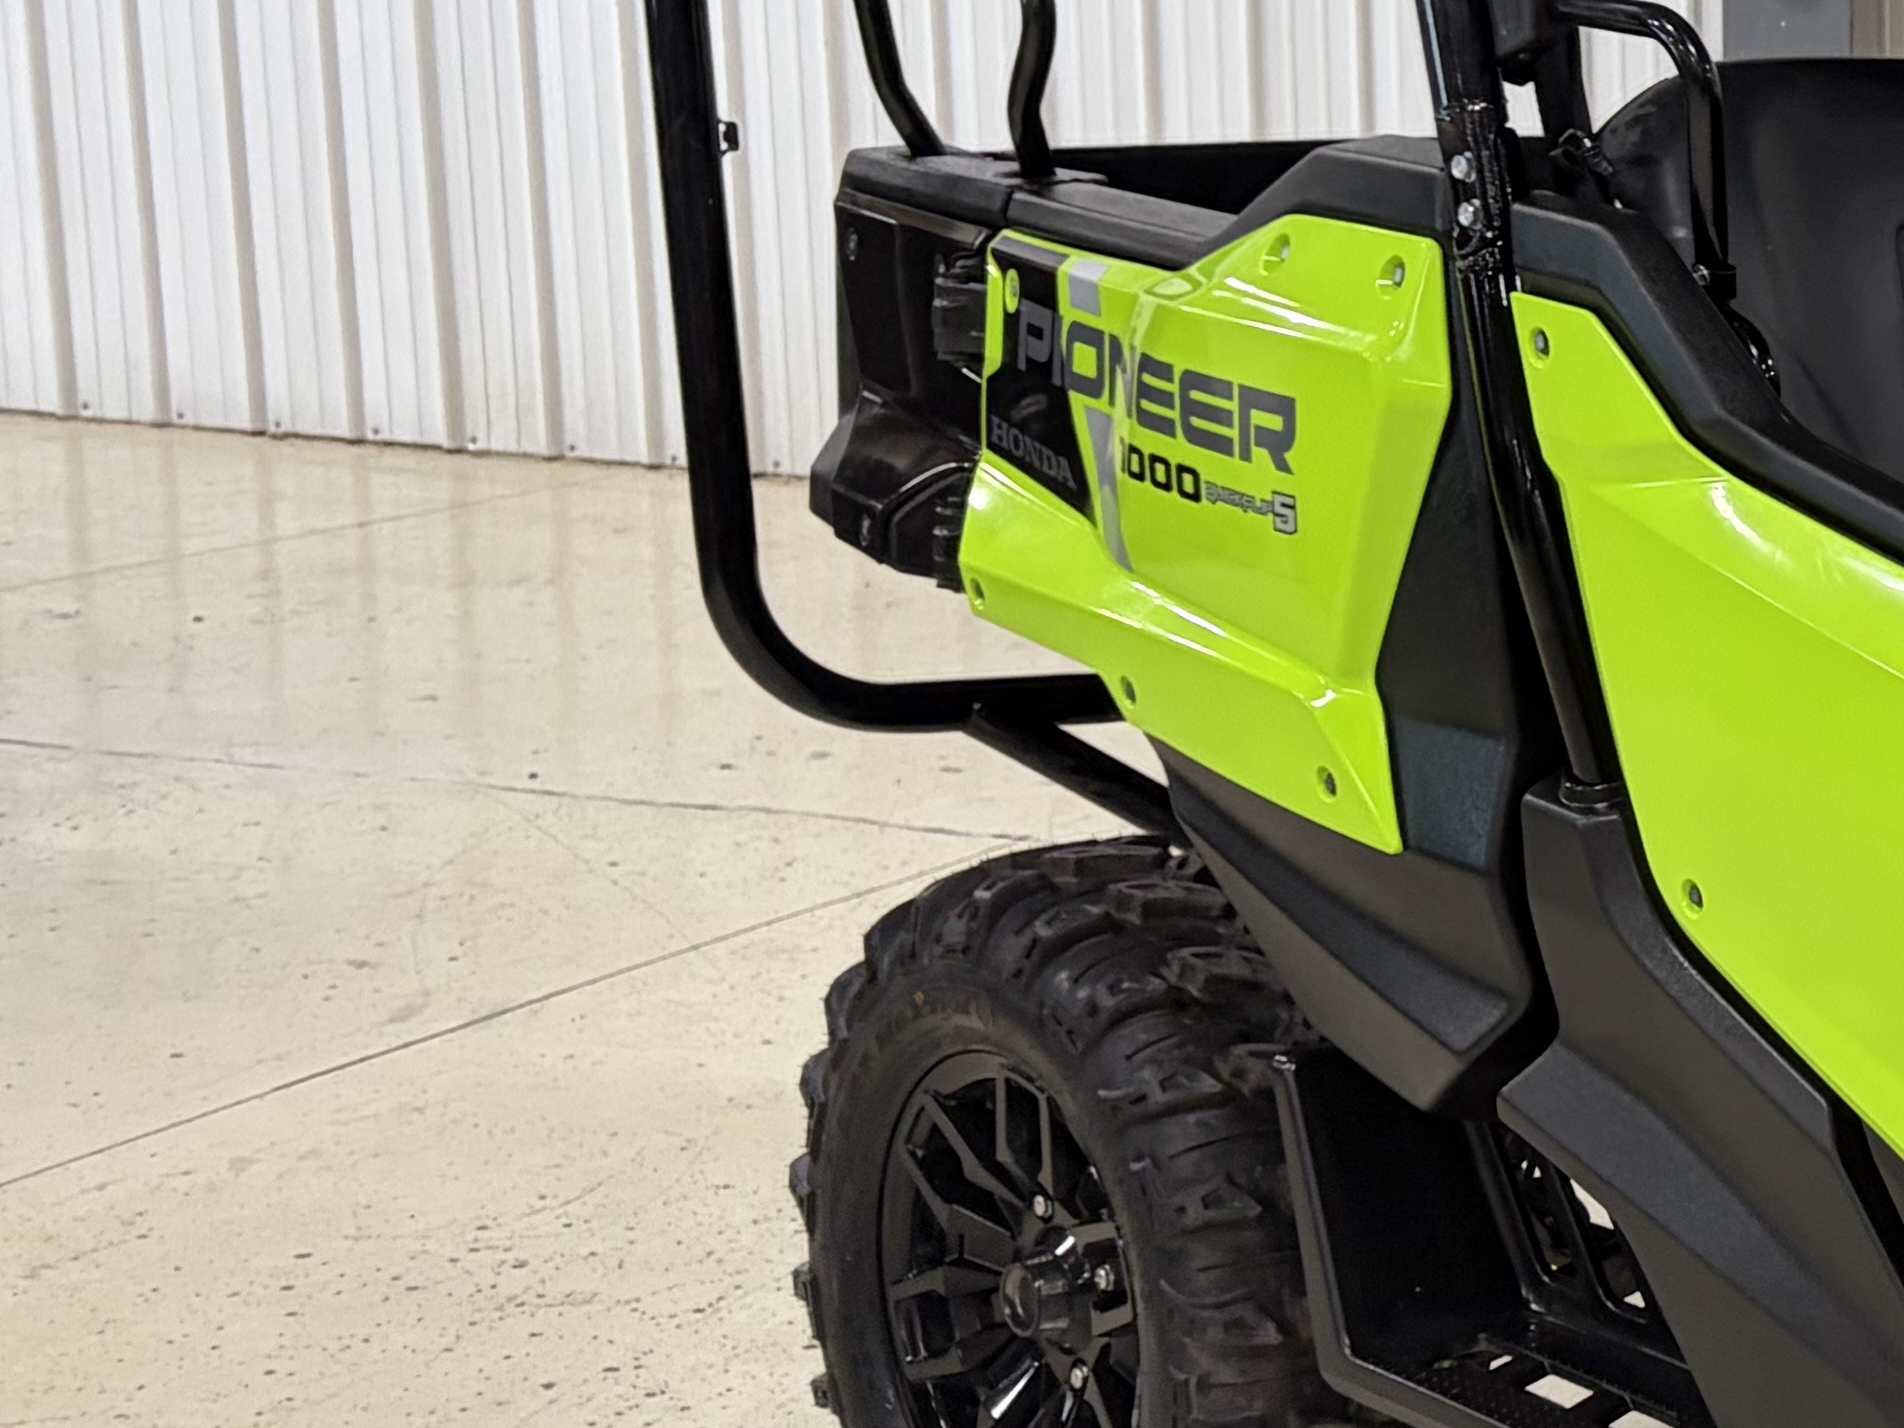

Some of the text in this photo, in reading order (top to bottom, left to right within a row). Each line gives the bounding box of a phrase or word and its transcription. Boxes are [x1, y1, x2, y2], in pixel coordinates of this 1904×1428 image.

[1017, 297, 1297, 476] PIONEER
[989, 414, 1078, 491] HONDA
[1119, 436, 1202, 504] 1000
